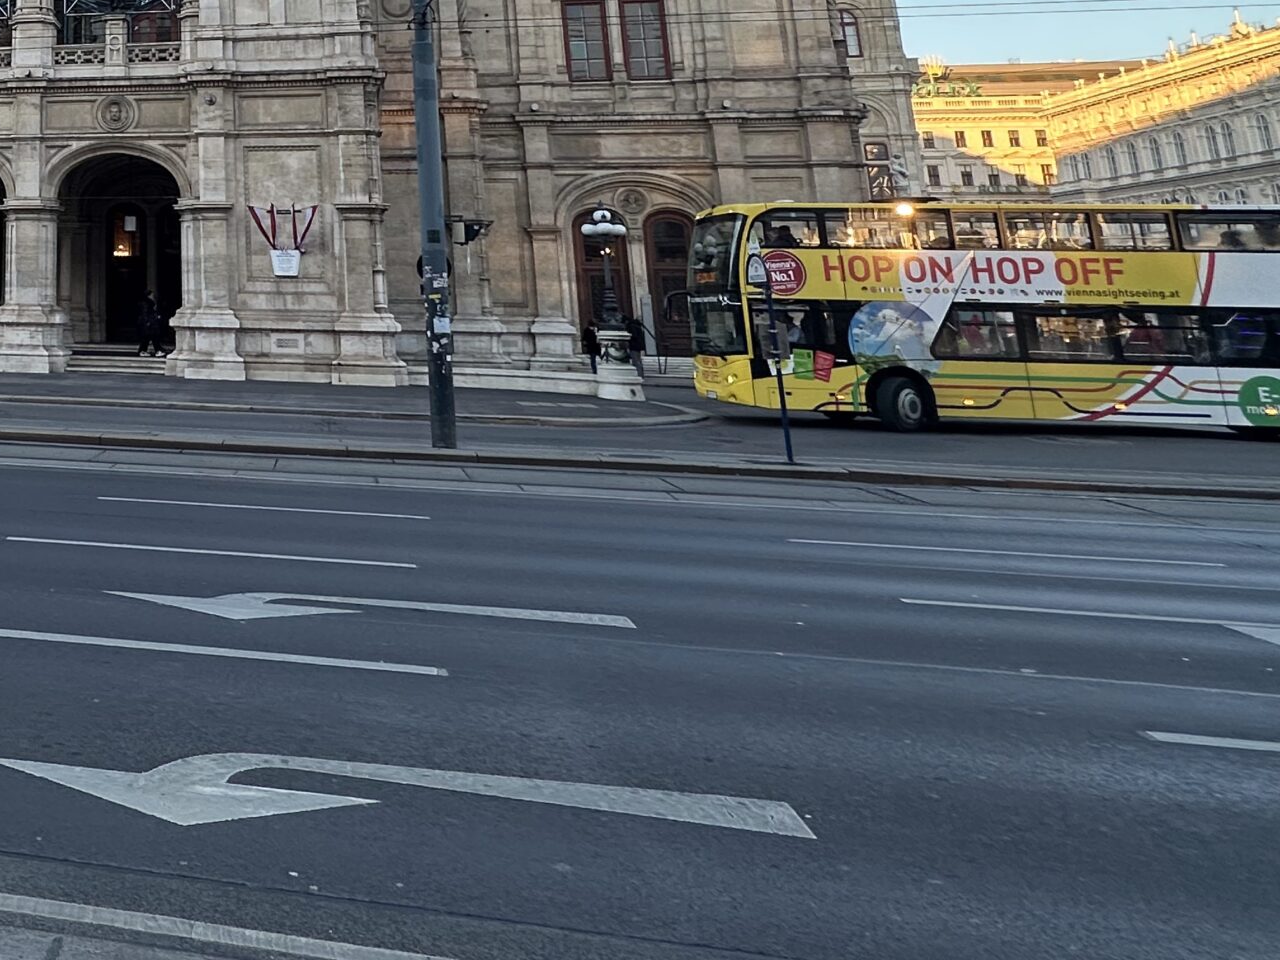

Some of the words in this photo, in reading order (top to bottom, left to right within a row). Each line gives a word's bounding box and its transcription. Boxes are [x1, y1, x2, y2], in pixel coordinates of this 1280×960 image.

[765, 260, 797, 269] Vienna's
[822, 254, 894, 282] HOP
[903, 256, 954, 283] ON
[970, 256, 1045, 285] HOP
[1053, 257, 1124, 286] OFF
[771, 270, 795, 282] No.1
[1035, 288, 1180, 300] www.viennasightseeing.at
[1258, 386, 1280, 402] E-
